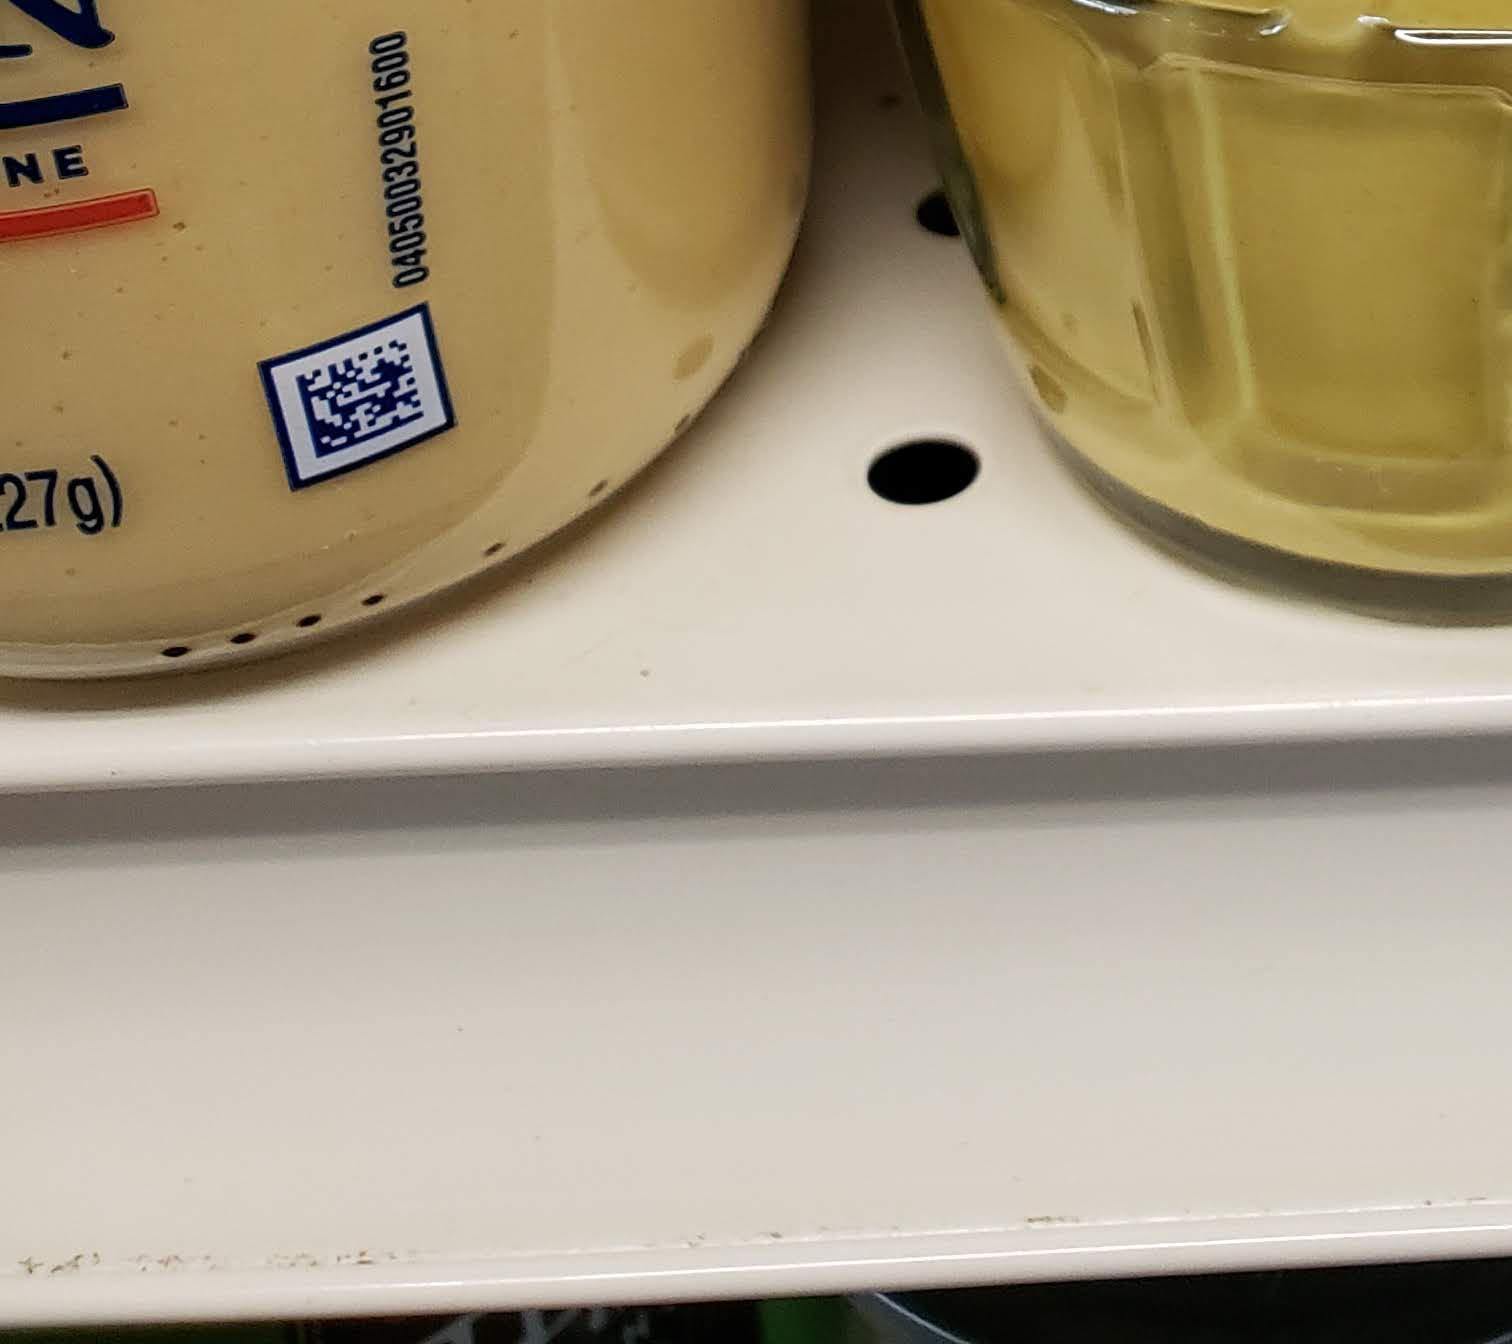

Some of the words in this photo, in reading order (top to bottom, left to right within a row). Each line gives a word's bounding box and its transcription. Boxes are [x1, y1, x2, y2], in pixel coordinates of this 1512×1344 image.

[2, 144, 90, 188] NE
[368, 30, 431, 289] 04050032901600
[0, 454, 124, 535] 27g)
